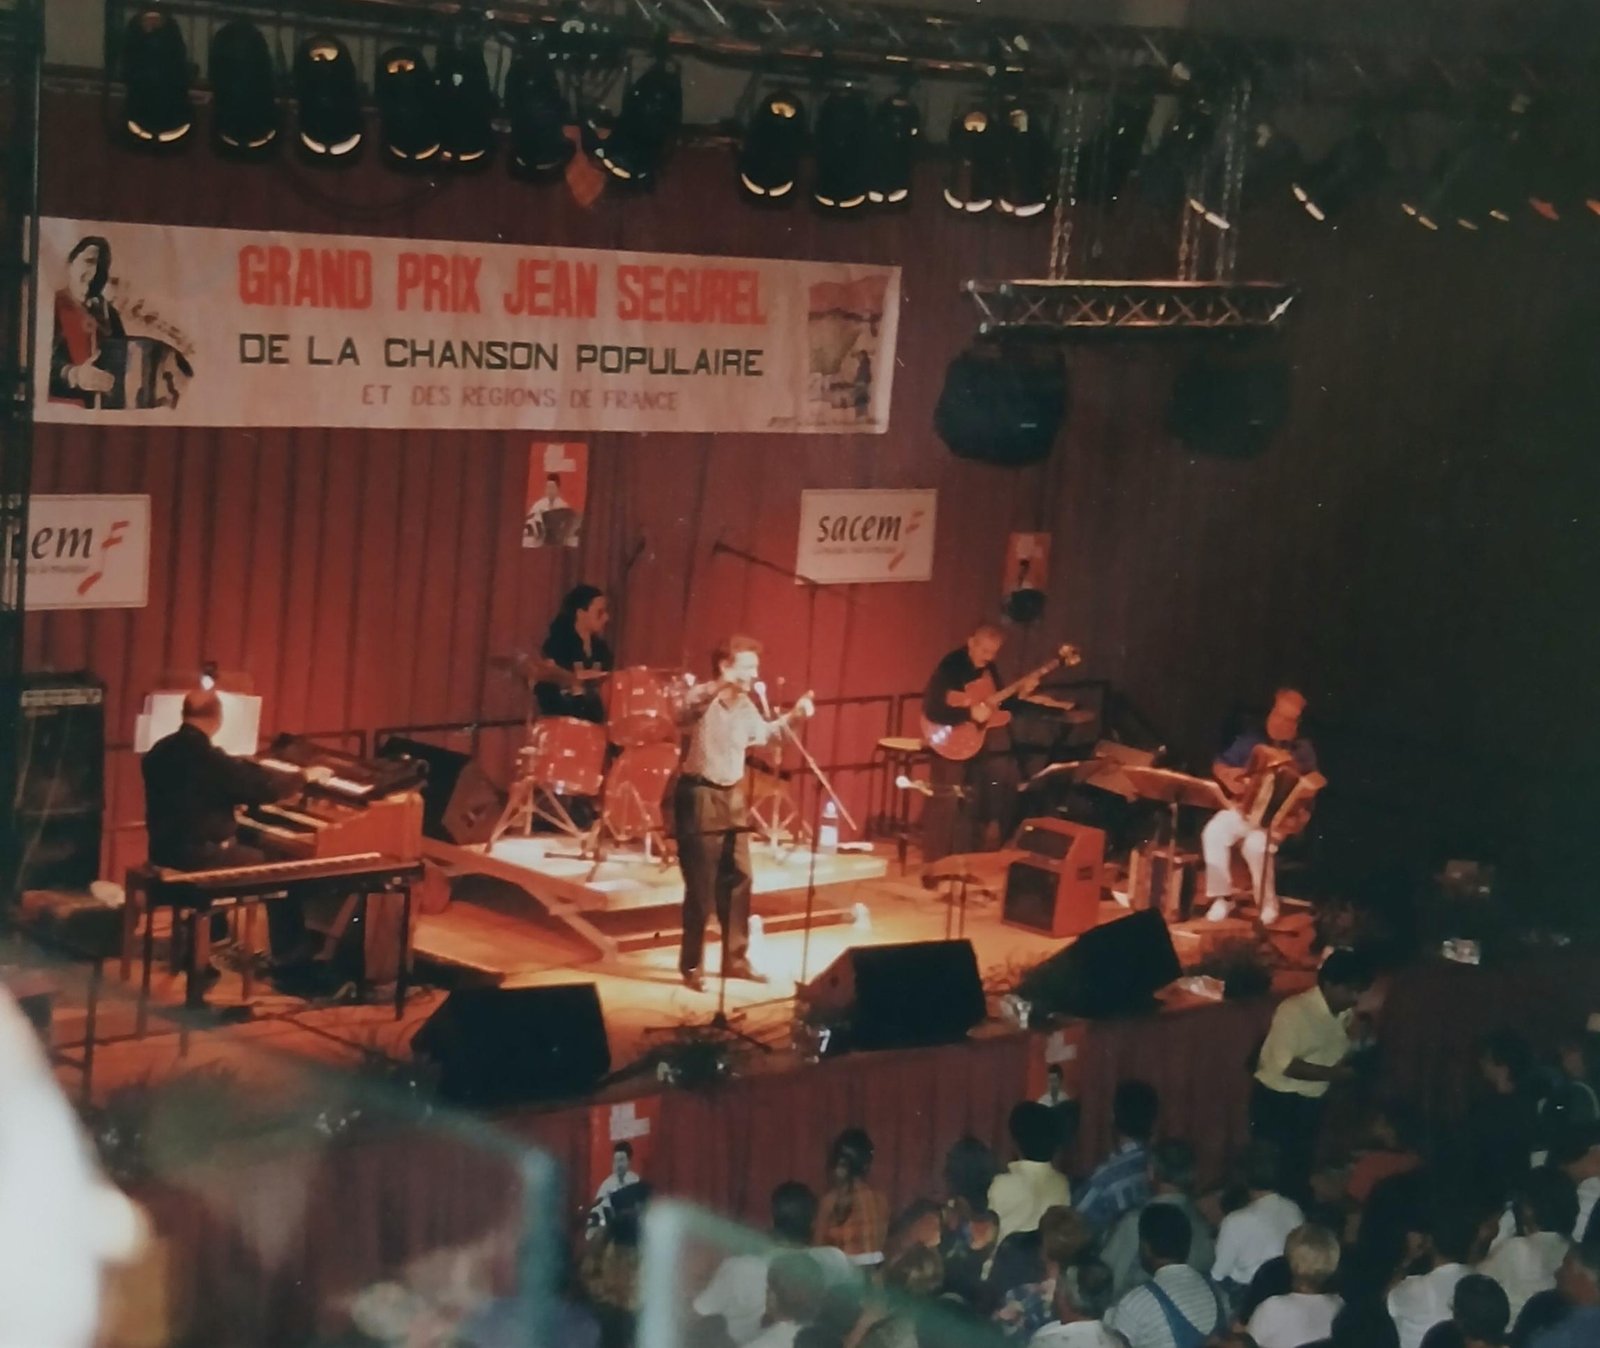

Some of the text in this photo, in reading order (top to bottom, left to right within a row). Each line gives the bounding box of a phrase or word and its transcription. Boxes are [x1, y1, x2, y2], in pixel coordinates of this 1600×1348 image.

[238, 244, 373, 311] GRAND
[397, 253, 482, 313] PRIX
[503, 257, 598, 319] JEAN
[239, 333, 764, 377] DE LA CHANSON POPULAIRE
[362, 384, 392, 406] ET
[411, 384, 451, 408] DES
[569, 387, 593, 409] DE
[603, 389, 680, 412] FRANCE
[816, 515, 902, 543] sacem
